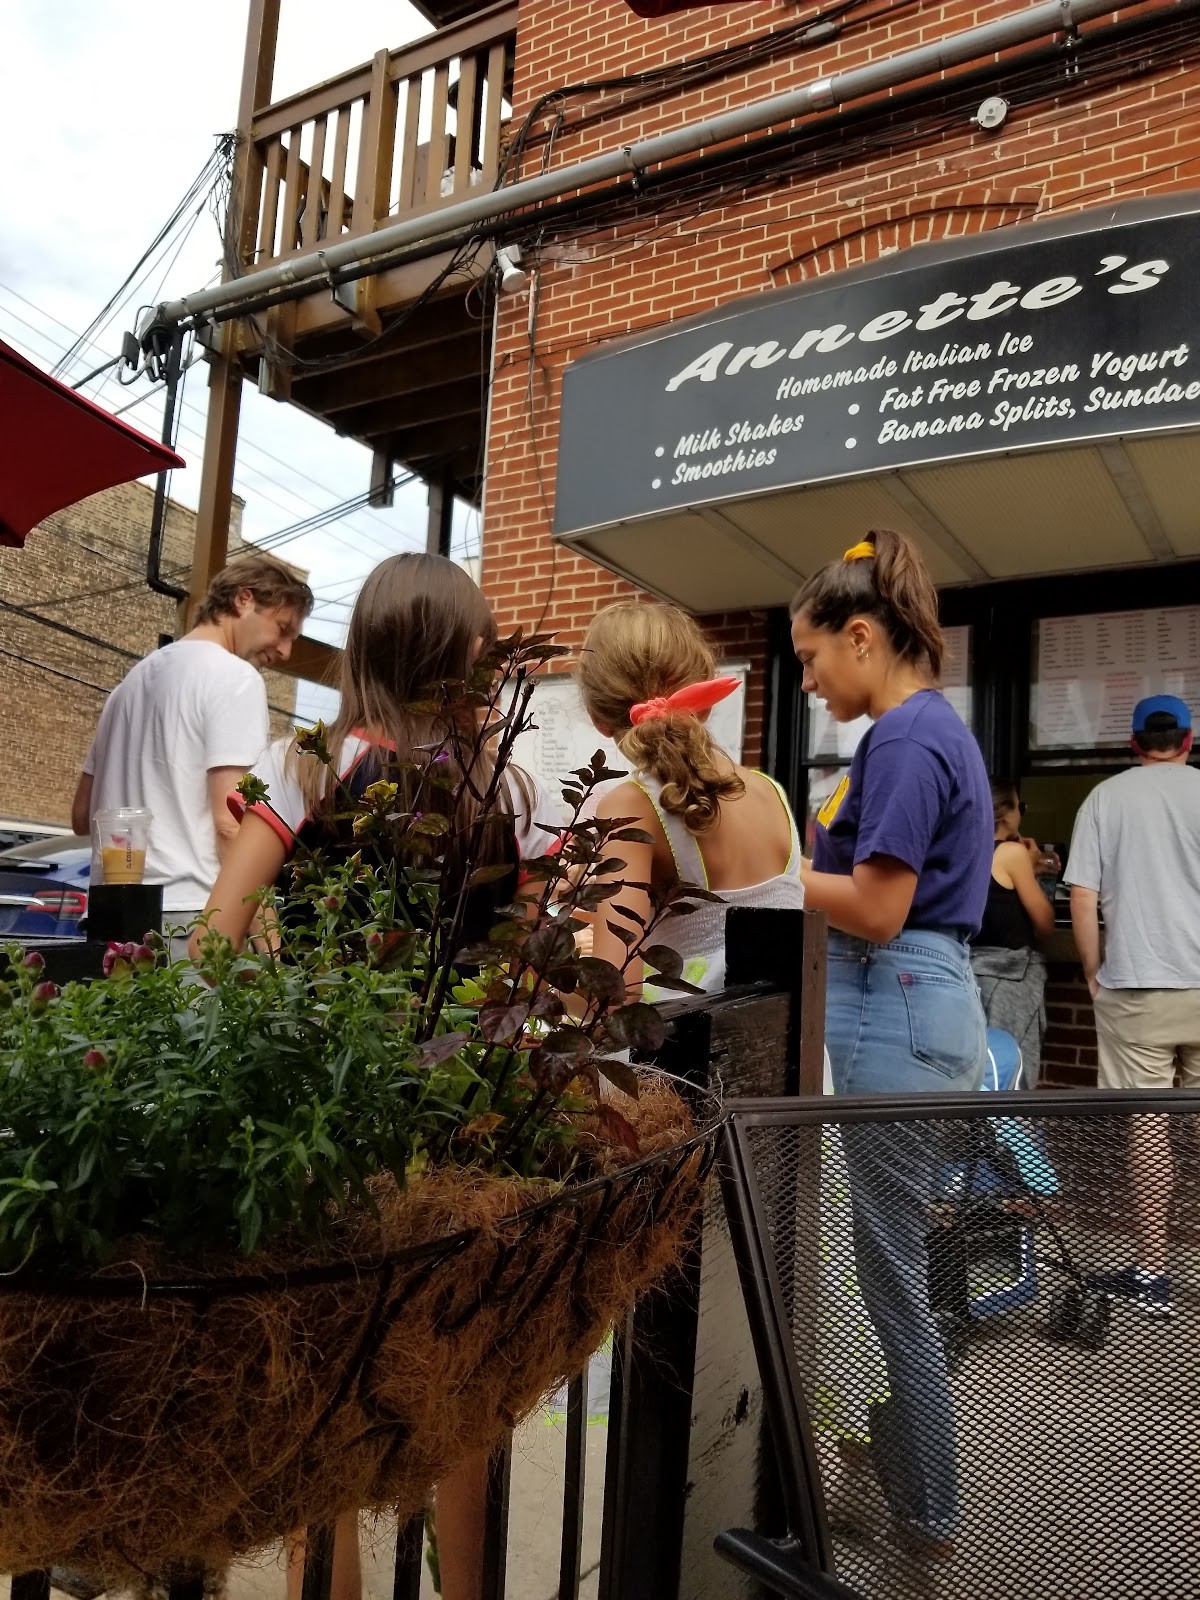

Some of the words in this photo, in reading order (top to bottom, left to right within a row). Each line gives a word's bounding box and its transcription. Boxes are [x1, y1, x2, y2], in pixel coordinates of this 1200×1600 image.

[665, 255, 1170, 391] Annette's
[776, 356, 898, 401] Homemade
[902, 342, 992, 376] Italian
[998, 331, 1034, 357] Ice
[879, 386, 924, 413] Fat
[928, 378, 982, 404] Free
[987, 363, 1081, 394] Frozen
[1090, 343, 1190, 382] Yogurt
[674, 428, 722, 459] Milk
[724, 413, 805, 446] Shakes
[878, 411, 985, 445] Banana
[989, 395, 1077, 432] Splits,
[671, 448, 777, 485] Smoothies
